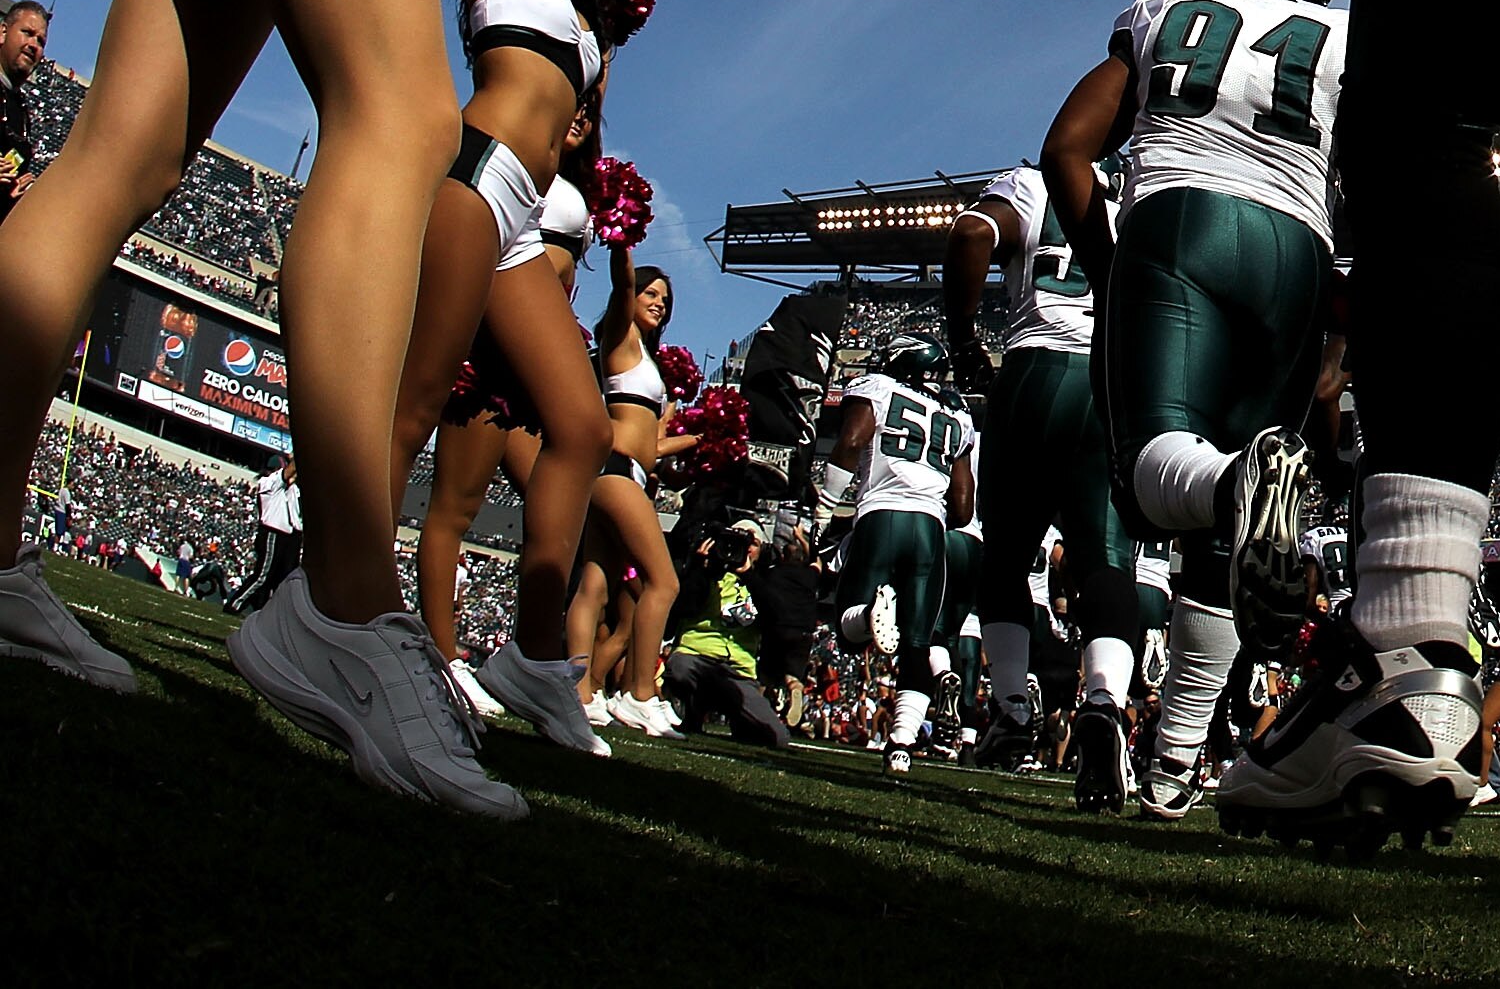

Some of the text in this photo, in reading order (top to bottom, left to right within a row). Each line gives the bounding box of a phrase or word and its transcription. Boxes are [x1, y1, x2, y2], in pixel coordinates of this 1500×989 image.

[1145, 0, 1332, 148] 91
[254, 358, 288, 388] MA
[262, 350, 286, 363] peps
[175, 401, 205, 418] verizon
[200, 384, 269, 422] MAXIMUM
[271, 411, 290, 429] TA
[203, 369, 290, 416] ZERO CALOR
[881, 392, 962, 477] 50
